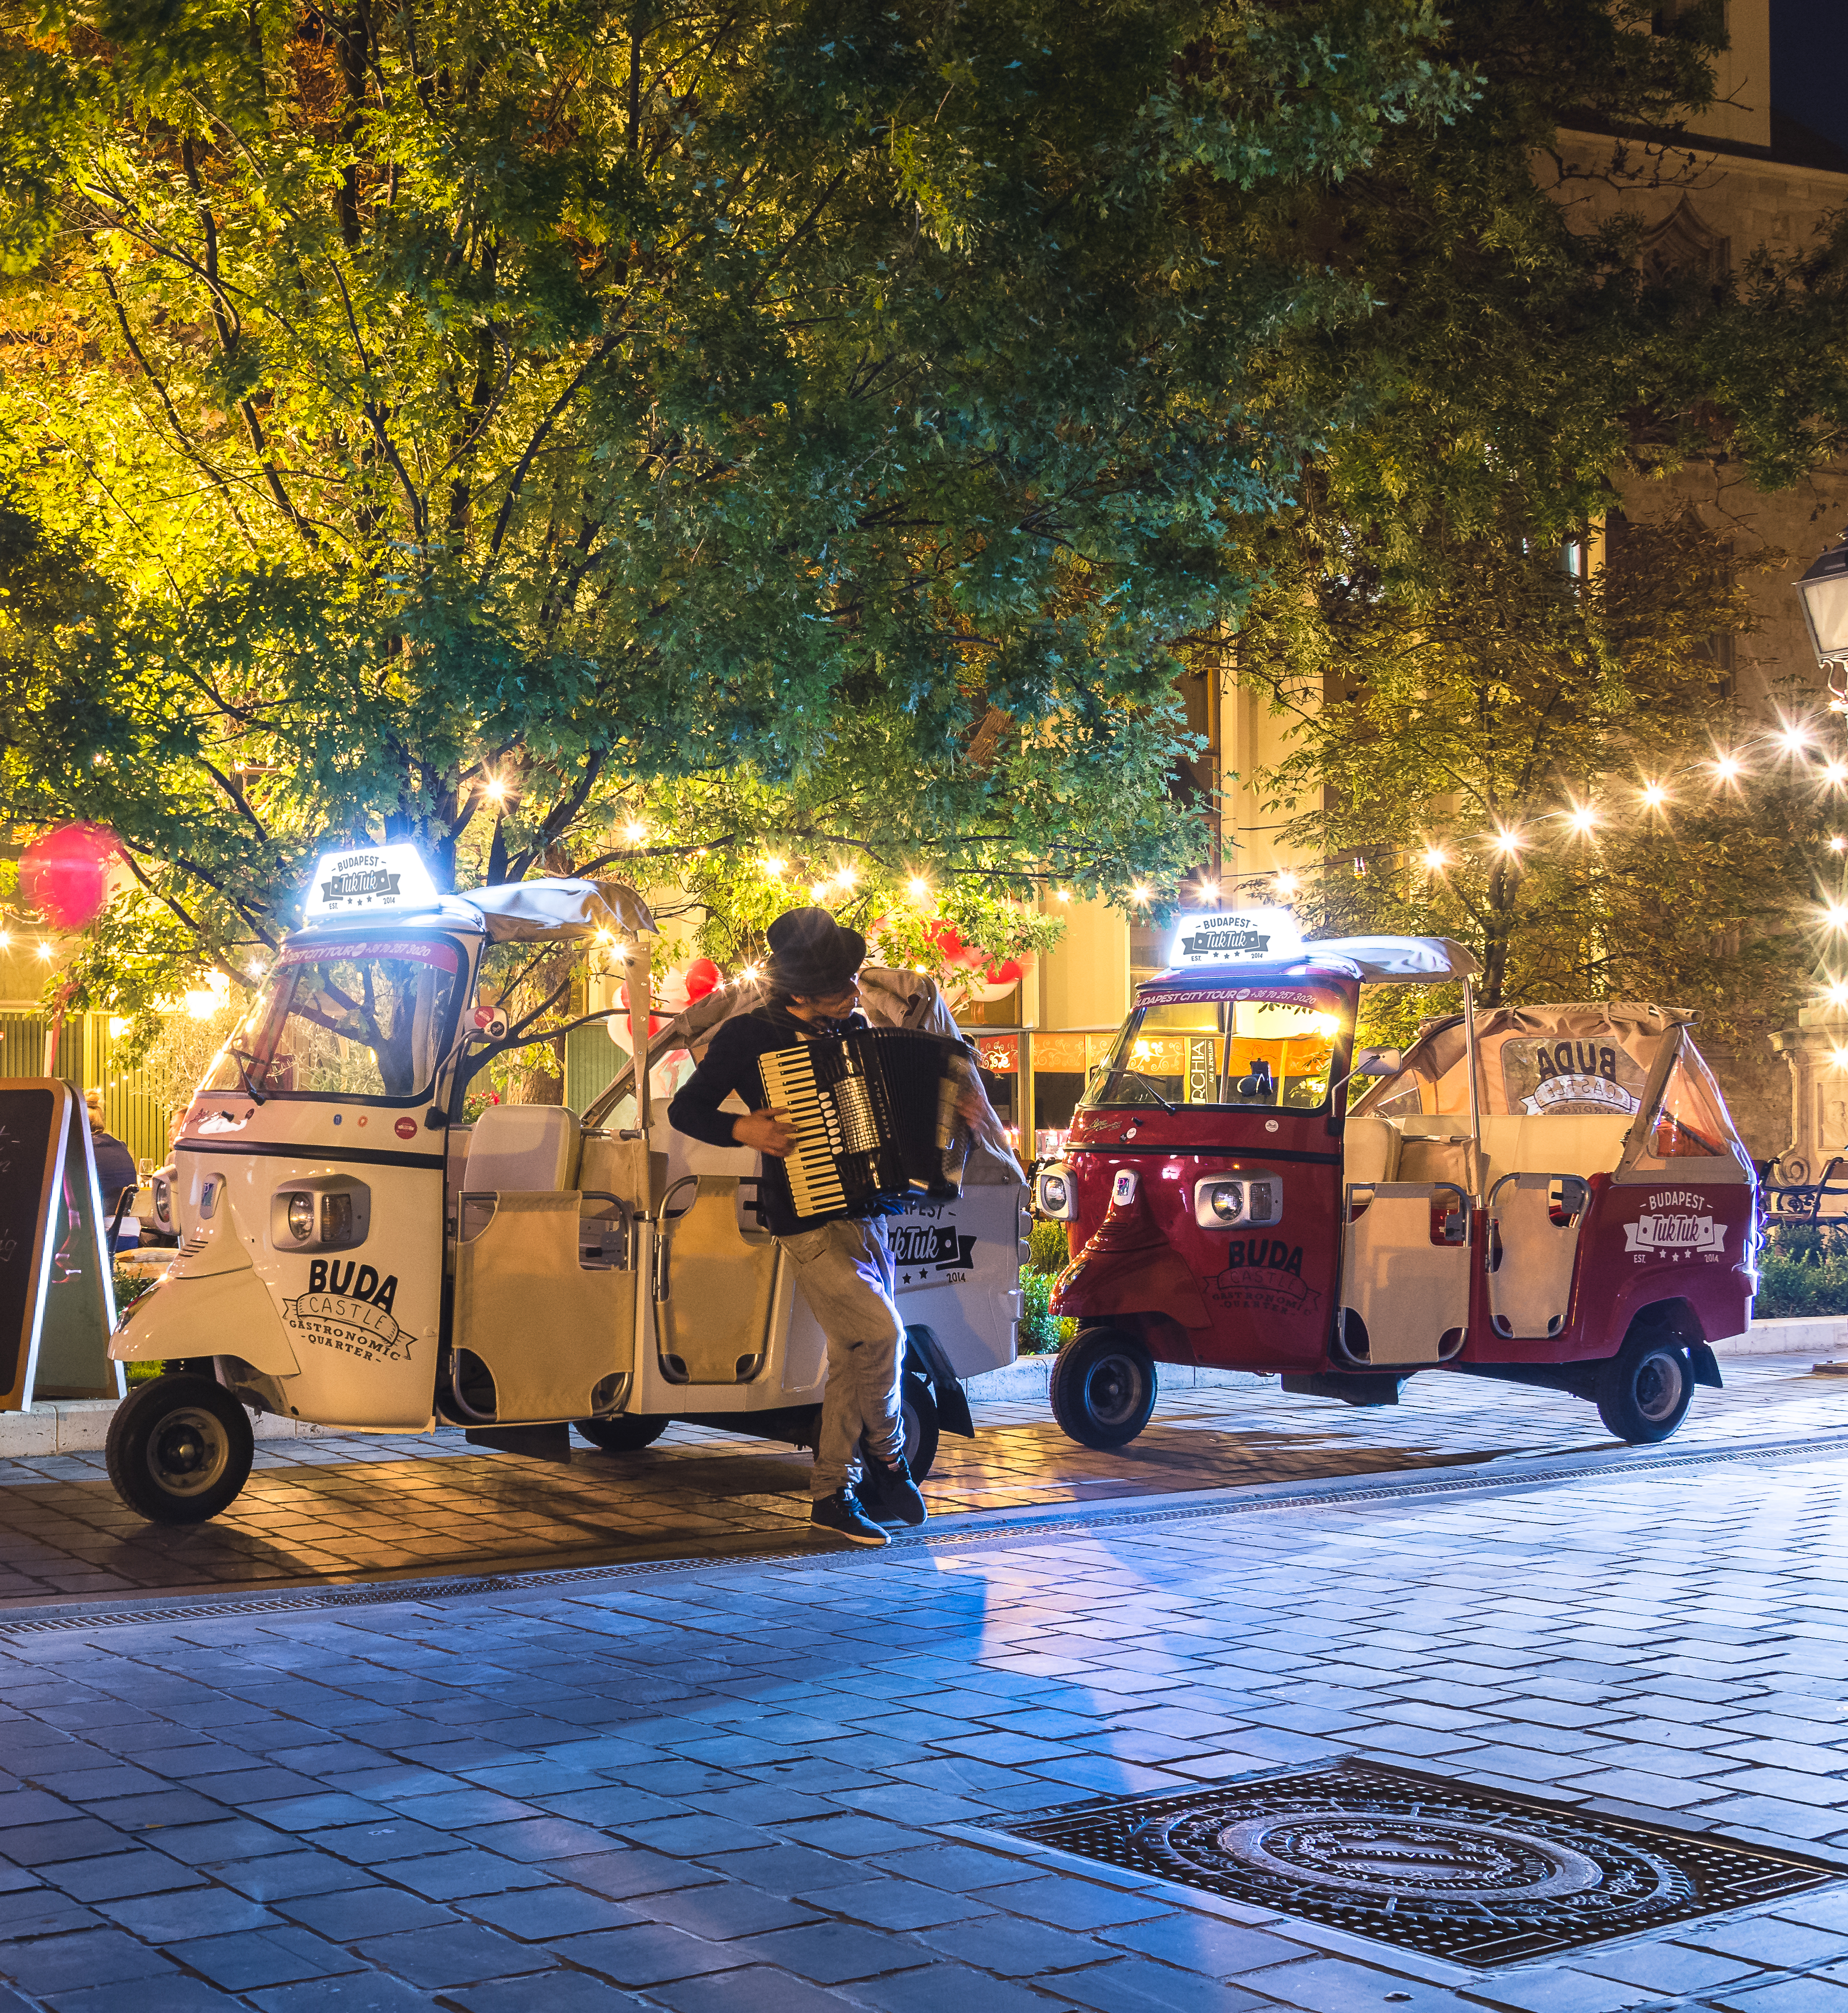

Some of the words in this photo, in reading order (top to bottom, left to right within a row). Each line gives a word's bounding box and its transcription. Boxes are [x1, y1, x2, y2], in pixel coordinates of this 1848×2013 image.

[337, 856, 379, 872] BUDAPEST
[340, 871, 378, 893] TukTuk
[1203, 917, 1251, 929] BUDAPEST
[1206, 931, 1247, 948] TukTuk
[325, 946, 354, 957] TOUR
[406, 944, 431, 957] 3020
[1134, 993, 1182, 1007] BUDAPEST
[1180, 991, 1207, 1001] CITY
[1206, 990, 1237, 999] TOUR
[1251, 990, 1267, 998] +36
[1266, 990, 1277, 998] 70
[1276, 991, 1295, 999] 257
[1293, 993, 1317, 1004] 3020
[1191, 1040, 1206, 1105] RCHIA
[1649, 1191, 1705, 1210] BUDAPEST
[903, 1204, 944, 1220] APEST
[1652, 1214, 1700, 1242] TukTuk
[889, 1226, 939, 1260] ukTuk
[1229, 1239, 1303, 1277] BUDA
[1704, 1254, 1719, 1263] 2014
[309, 1259, 398, 1315] BUDA
[946, 1272, 966, 1283] 2014
[1230, 1271, 1297, 1290] CASTLE
[310, 1297, 387, 1330] CASTLE
[1224, 1300, 1288, 1314] QUARTER
[289, 1320, 401, 1361] GASTRONOMIC
[308, 1334, 373, 1361] QUARTER
